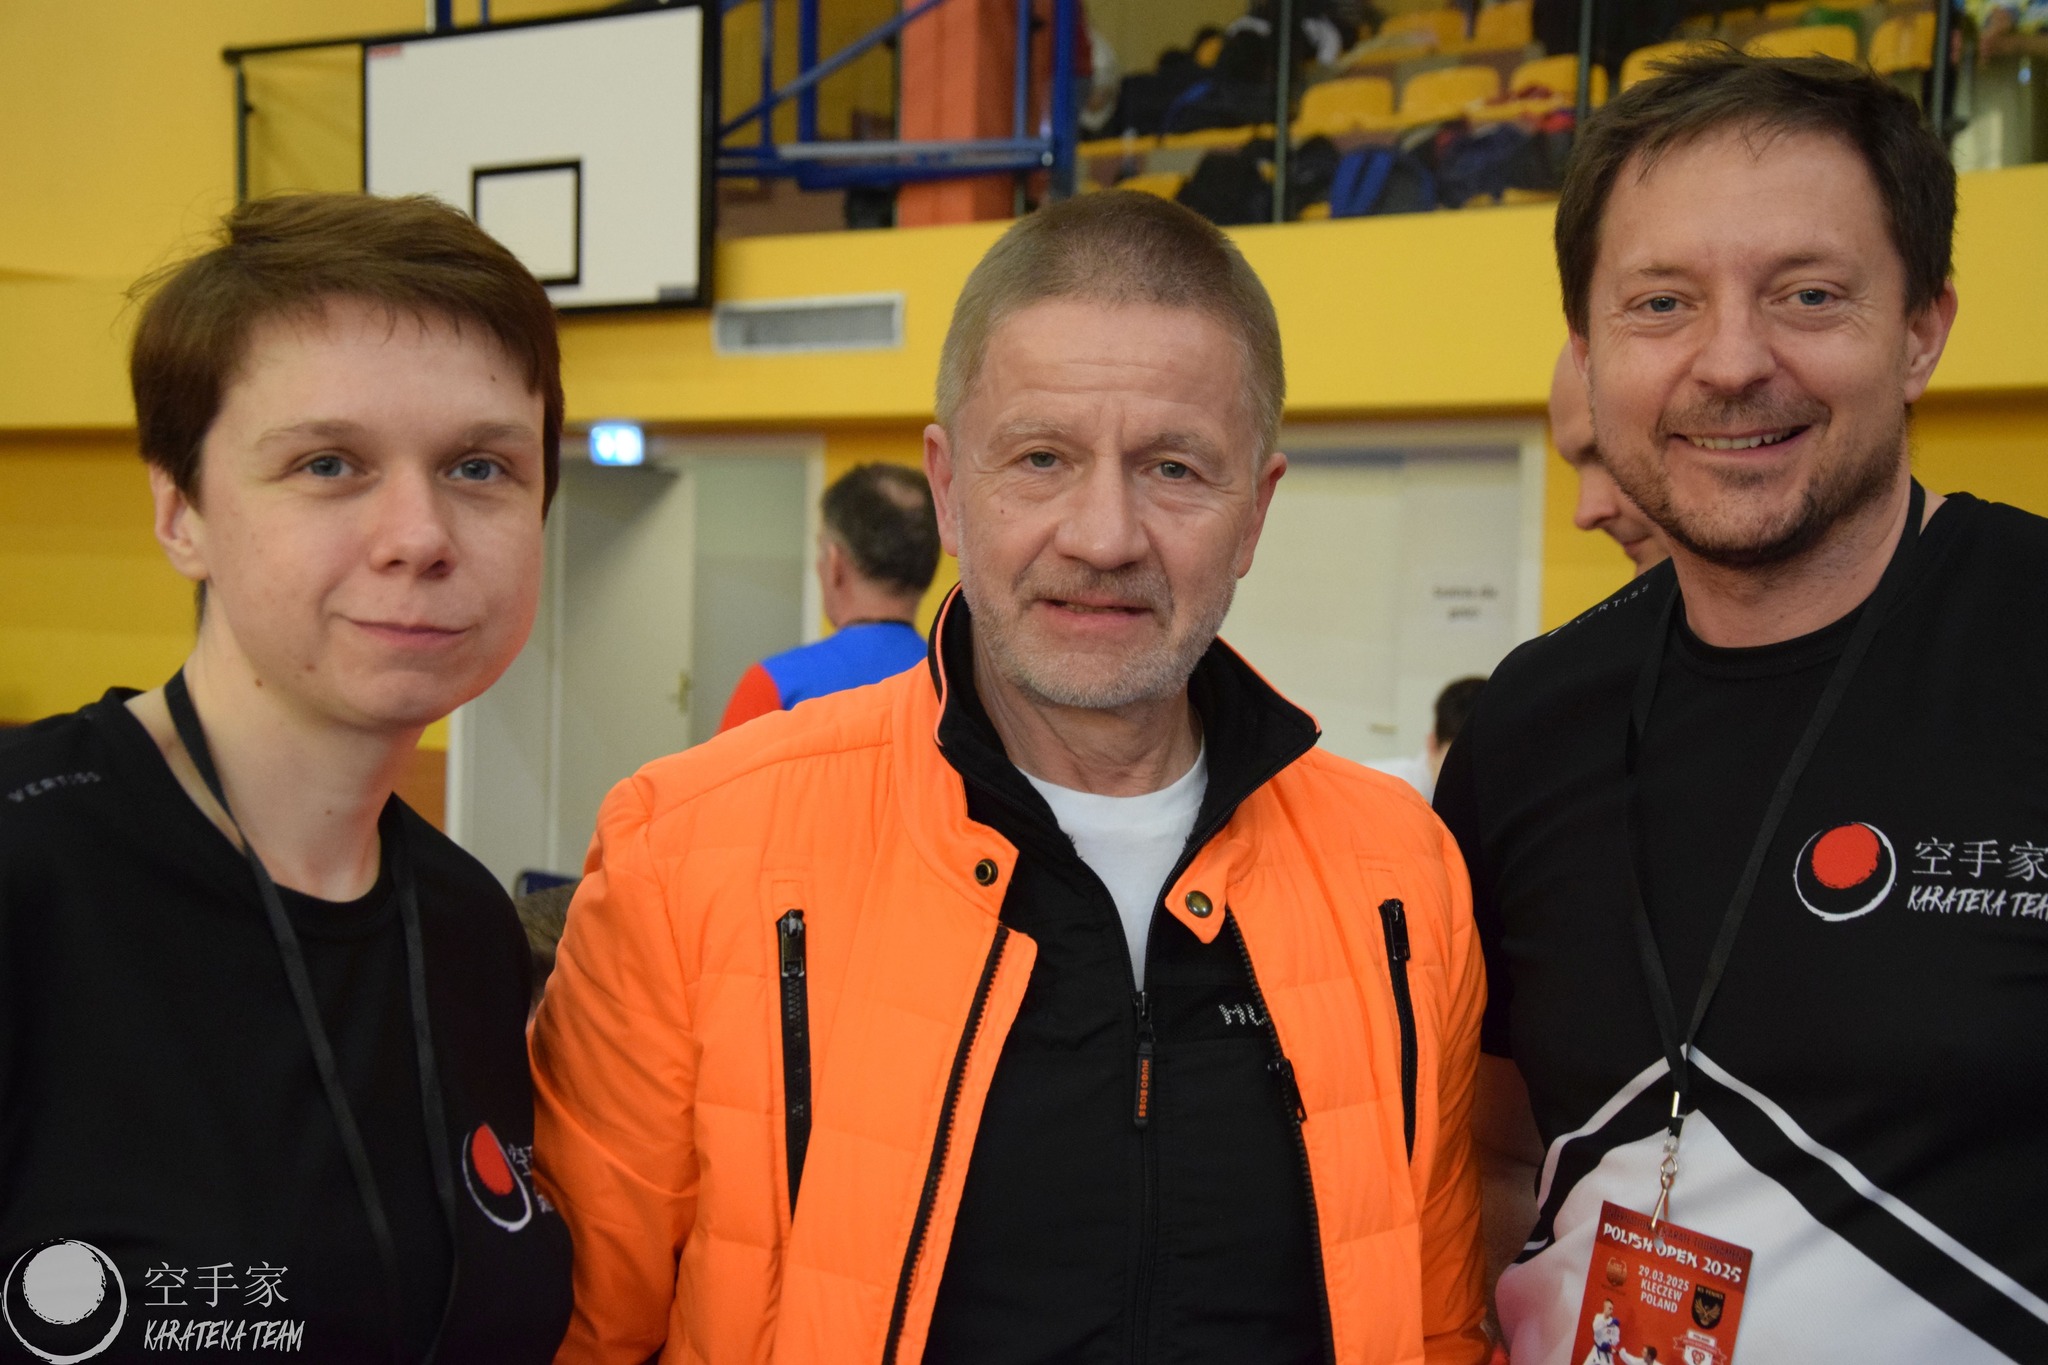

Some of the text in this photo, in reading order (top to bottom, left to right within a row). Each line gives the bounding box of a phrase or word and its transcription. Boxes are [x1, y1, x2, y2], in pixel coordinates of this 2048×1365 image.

[1912, 837, 2048, 881] 空手家
[1907, 885, 2007, 917] KARATEKA
[1138, 1059, 1149, 1117] HUGO BOSS
[1606, 1206, 1661, 1234] INTERNATIONL
[1603, 1222, 1653, 1253] POLISH
[1655, 1241, 1698, 1268] OPEN
[1702, 1256, 1742, 1282] 2025
[1638, 1265, 1690, 1291] 29.03.2025
[1640, 1279, 1683, 1302] KLECZEW
[1641, 1292, 1678, 1313] POLAND
